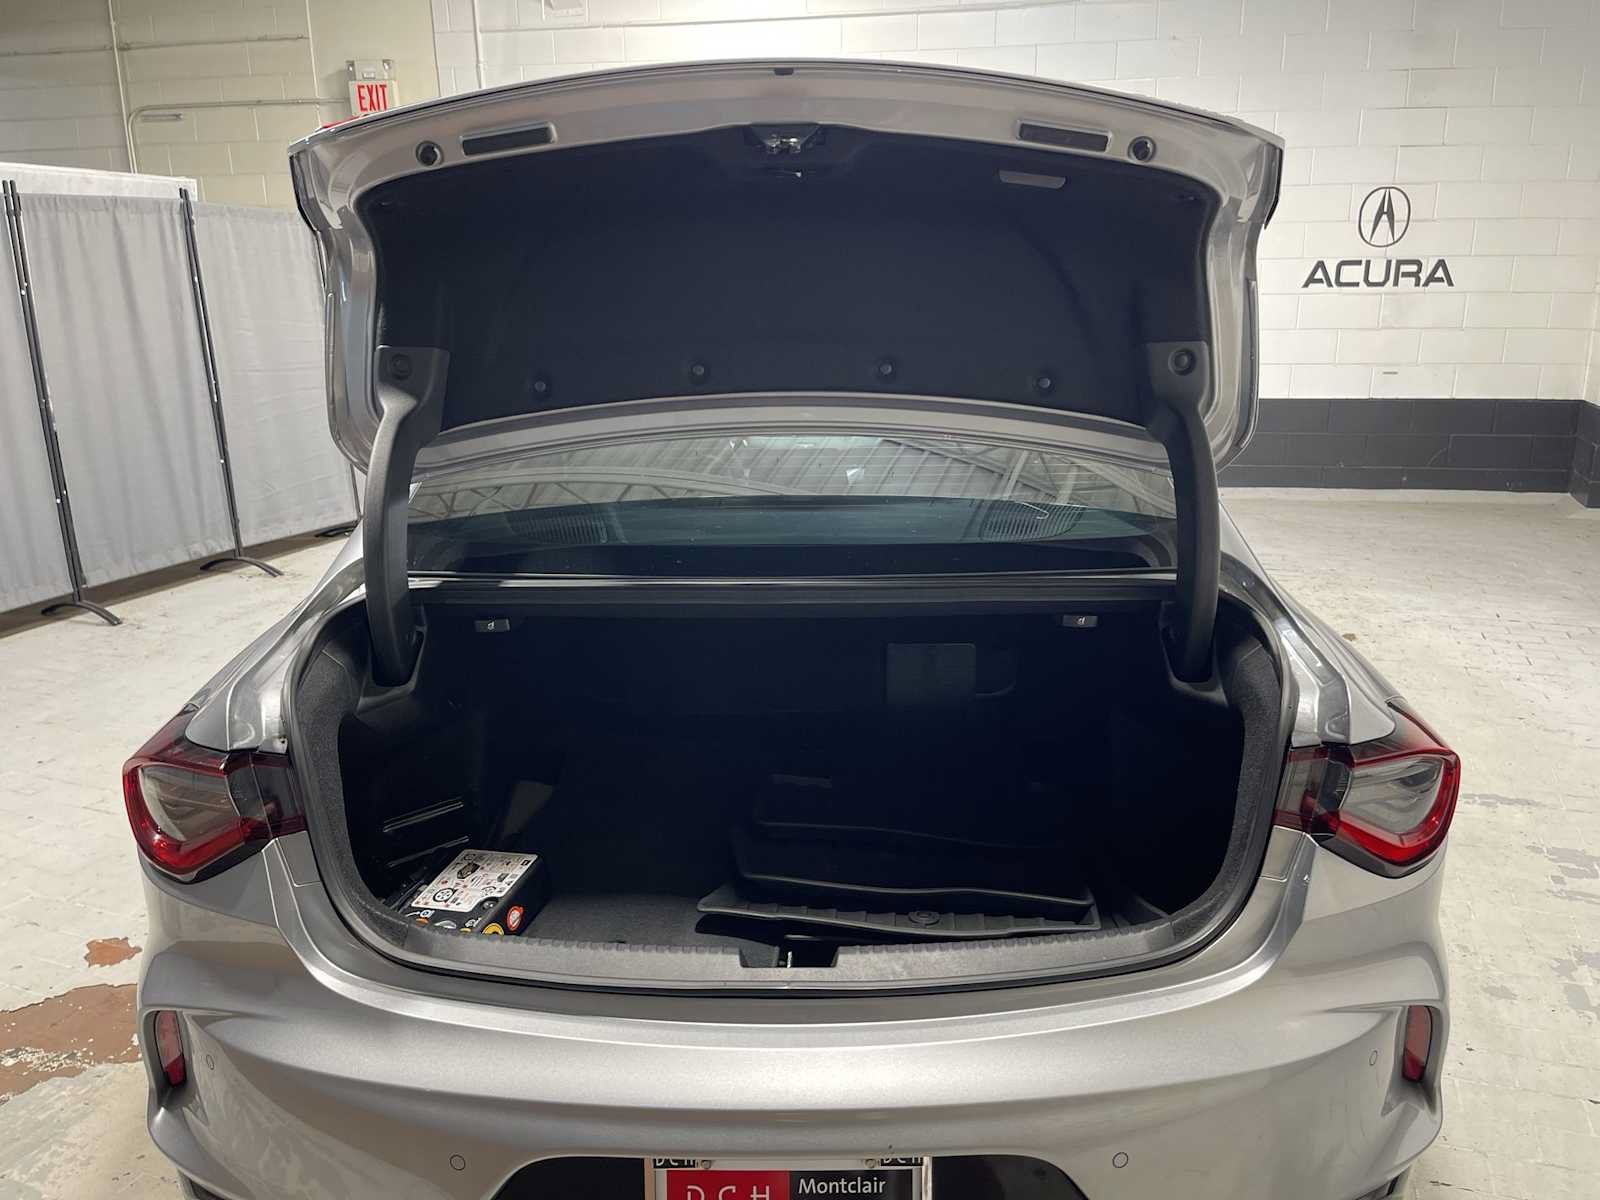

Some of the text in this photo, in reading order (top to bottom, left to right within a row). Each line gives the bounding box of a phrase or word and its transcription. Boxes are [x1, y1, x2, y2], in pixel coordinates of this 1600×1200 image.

[357, 84, 387, 112] EXIT
[1301, 258, 1455, 288] ACURA
[798, 1176, 887, 1194] Montclair
